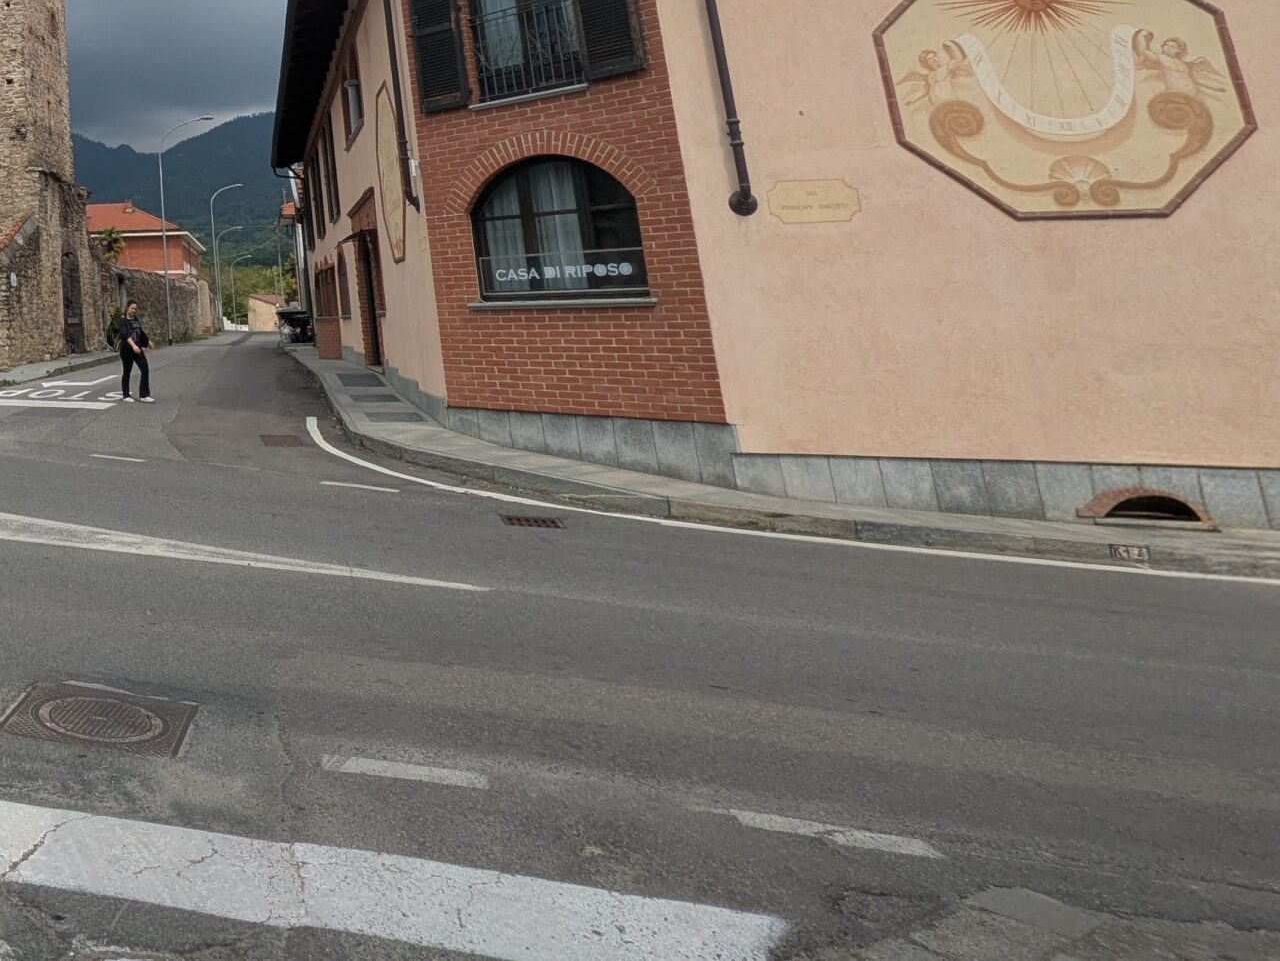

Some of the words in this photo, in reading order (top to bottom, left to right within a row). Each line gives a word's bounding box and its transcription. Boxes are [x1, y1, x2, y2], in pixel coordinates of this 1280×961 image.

[1056, 121, 1073, 132] XII
[495, 267, 540, 281] CASA
[543, 265, 561, 279] DI
[564, 262, 633, 278] RIPOSO
